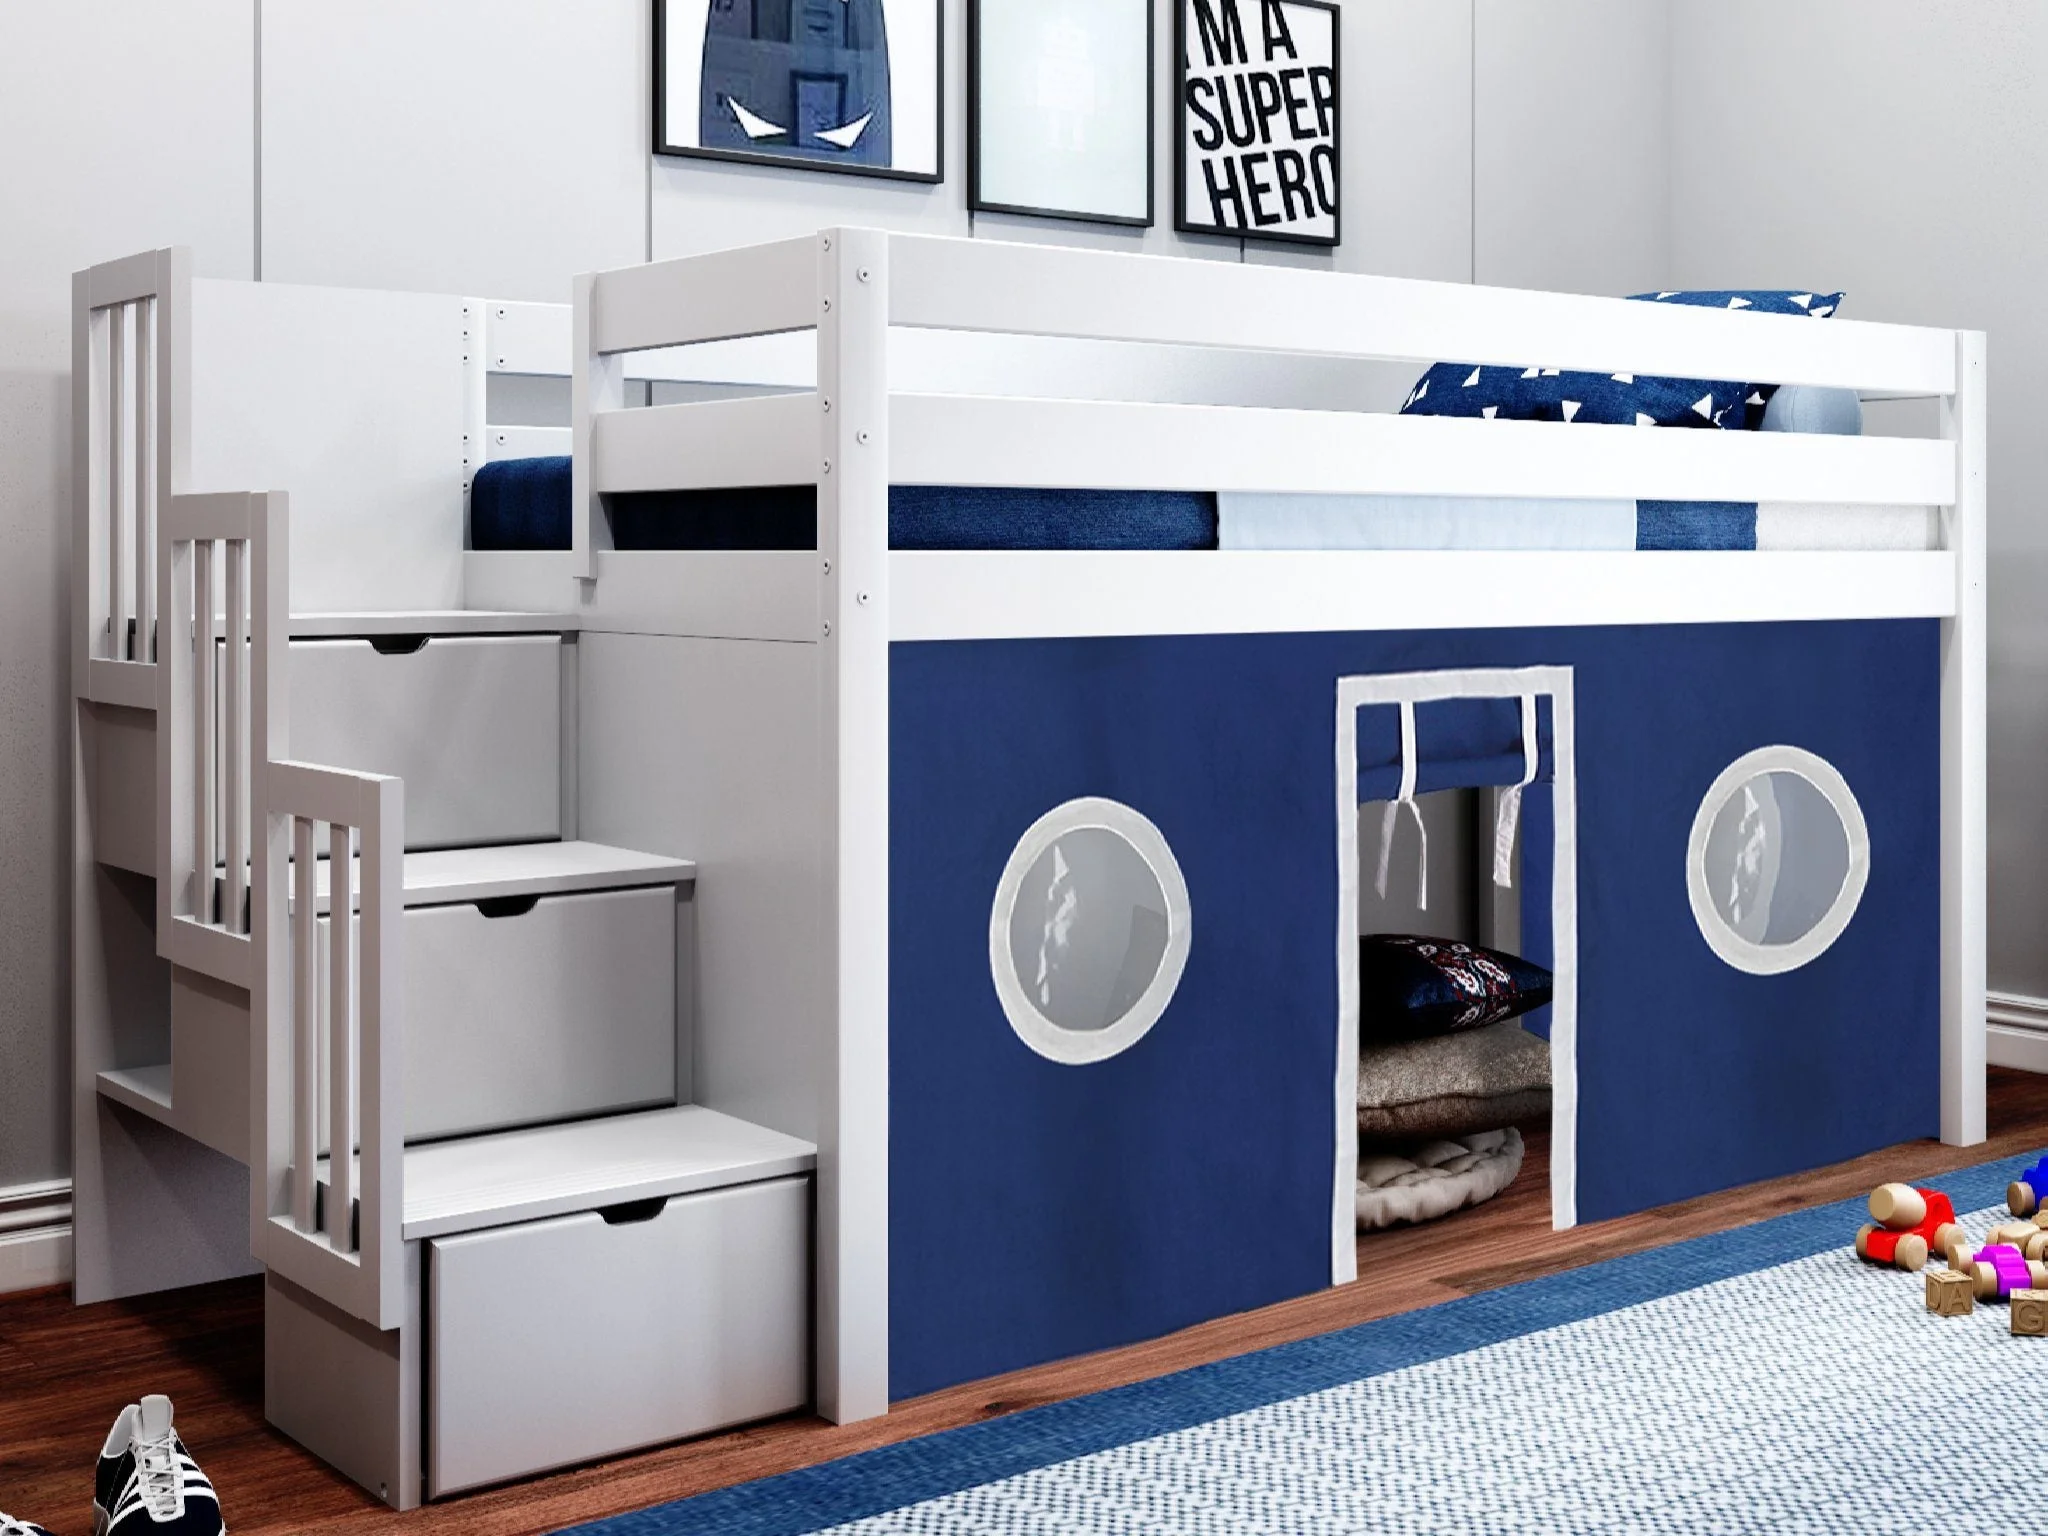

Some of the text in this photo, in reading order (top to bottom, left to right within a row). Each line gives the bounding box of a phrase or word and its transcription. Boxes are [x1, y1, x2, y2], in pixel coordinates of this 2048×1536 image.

[1186, 0, 1298, 69] M A
[1202, 144, 1336, 228] HERO
[1947, 1282, 1970, 1312] A
[2015, 1301, 2044, 1332] G
